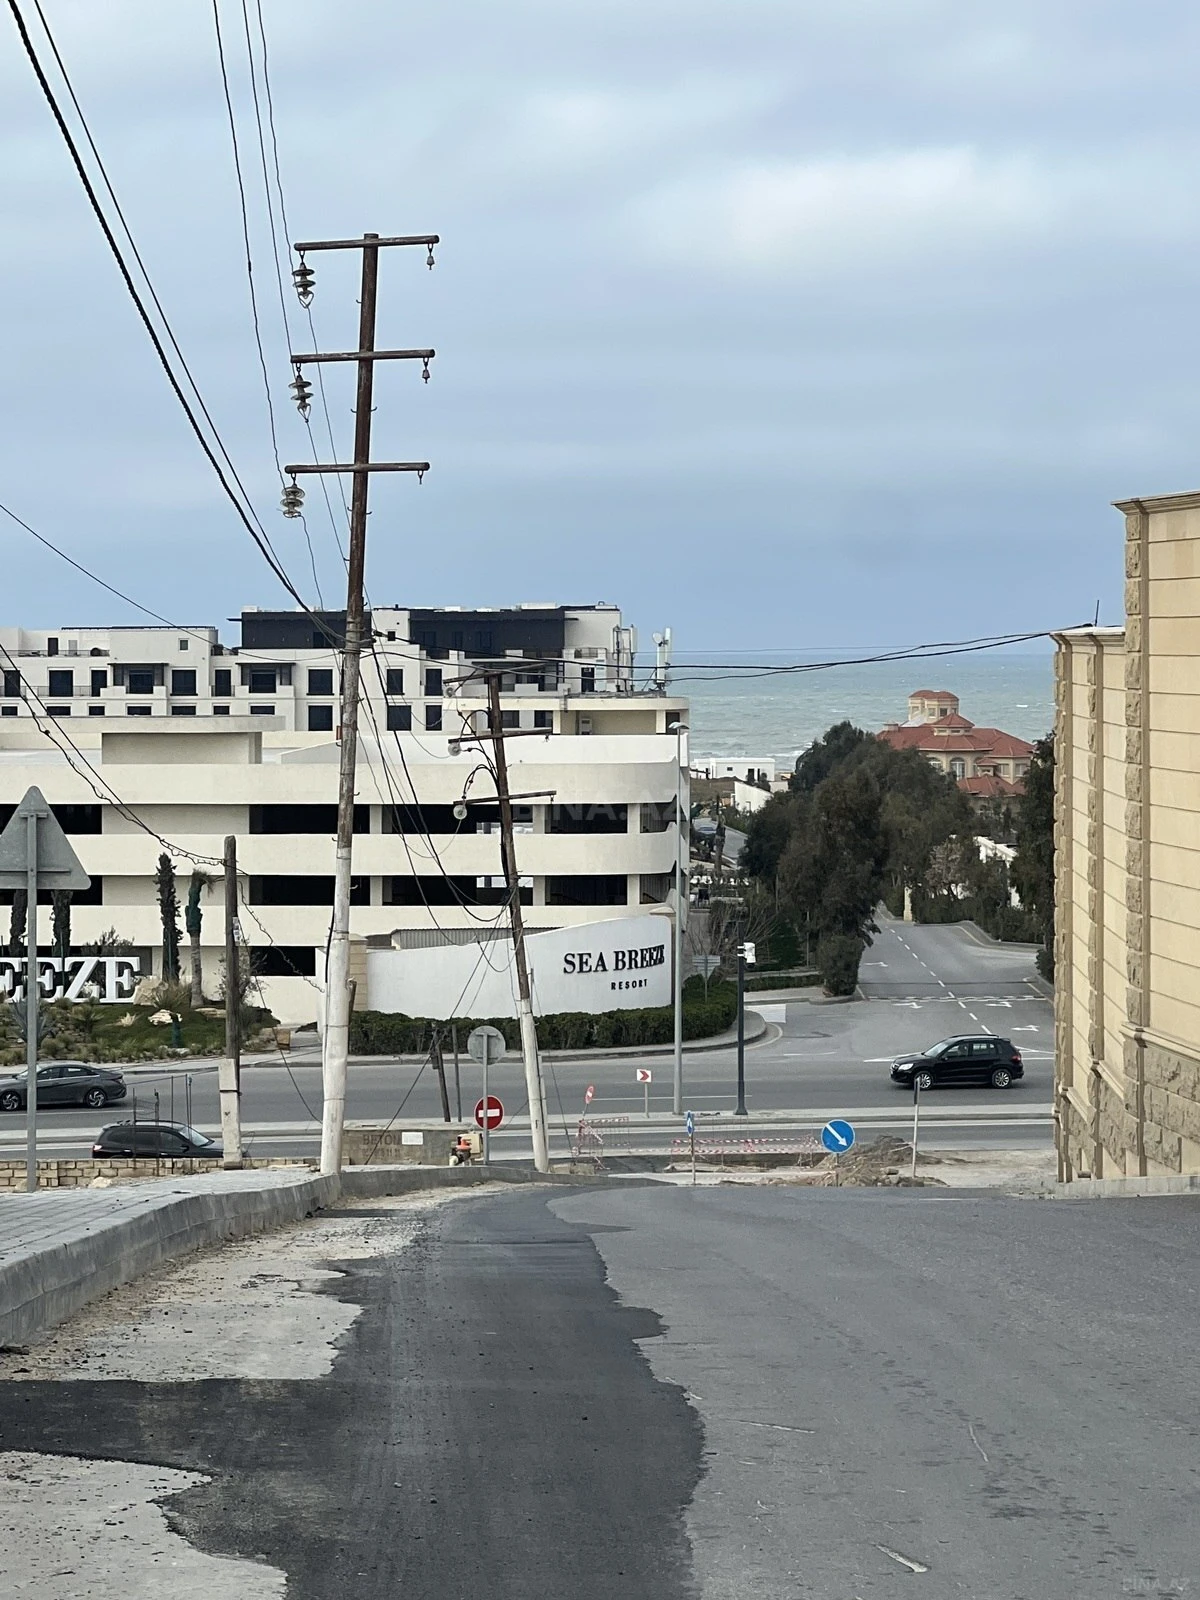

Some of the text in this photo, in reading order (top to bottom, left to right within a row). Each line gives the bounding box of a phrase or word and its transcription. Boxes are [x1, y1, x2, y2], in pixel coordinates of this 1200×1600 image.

[563, 944, 664, 974] SEA BREEZE
[611, 978, 648, 990] RESORT
